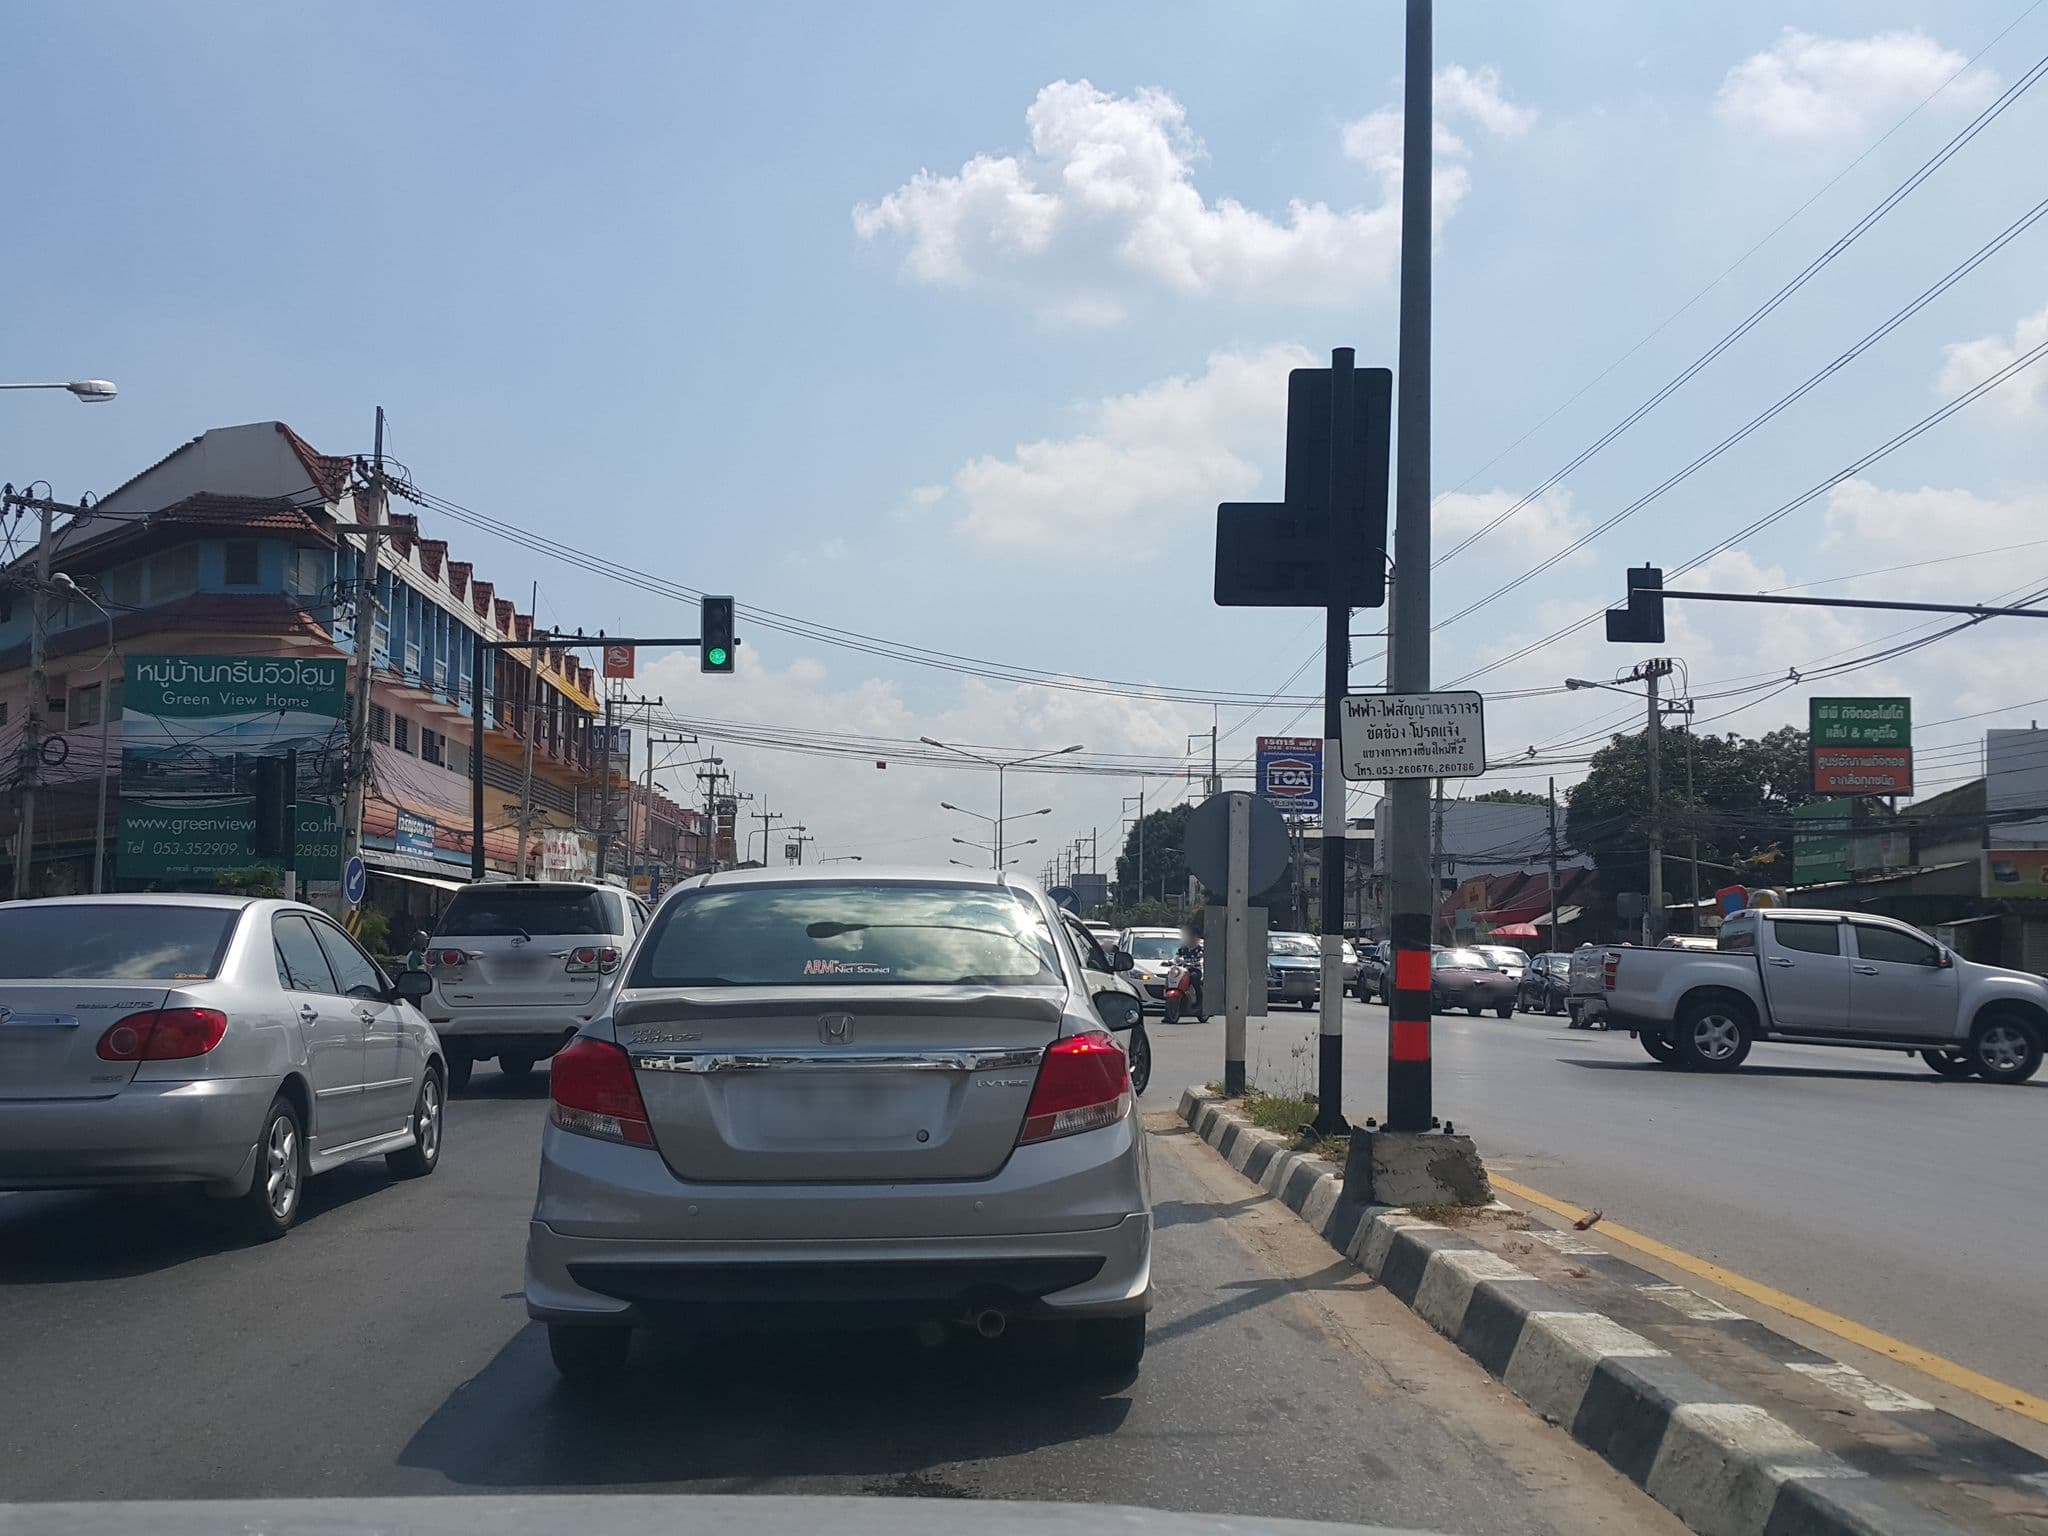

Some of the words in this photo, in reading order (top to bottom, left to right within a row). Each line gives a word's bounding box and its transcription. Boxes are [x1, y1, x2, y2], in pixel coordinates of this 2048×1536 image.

[136, 658, 336, 688] หมู่บ้านกรีนวิวโฮม
[161, 690, 210, 706] Green
[219, 691, 258, 706] View
[265, 692, 310, 708] Home
[1345, 698, 1479, 719] ไฟฟ้า-ไฟสัญญาณจราจร
[1366, 723, 1406, 740] ขัดข้อง
[1409, 721, 1460, 740] โปรดแจ้ง
[1850, 727, 1861, 739] &
[1457, 745, 1465, 755] 2
[1270, 770, 1310, 786] TOA
[126, 839, 145, 854] Tel
[856, 965, 891, 974] Sound
